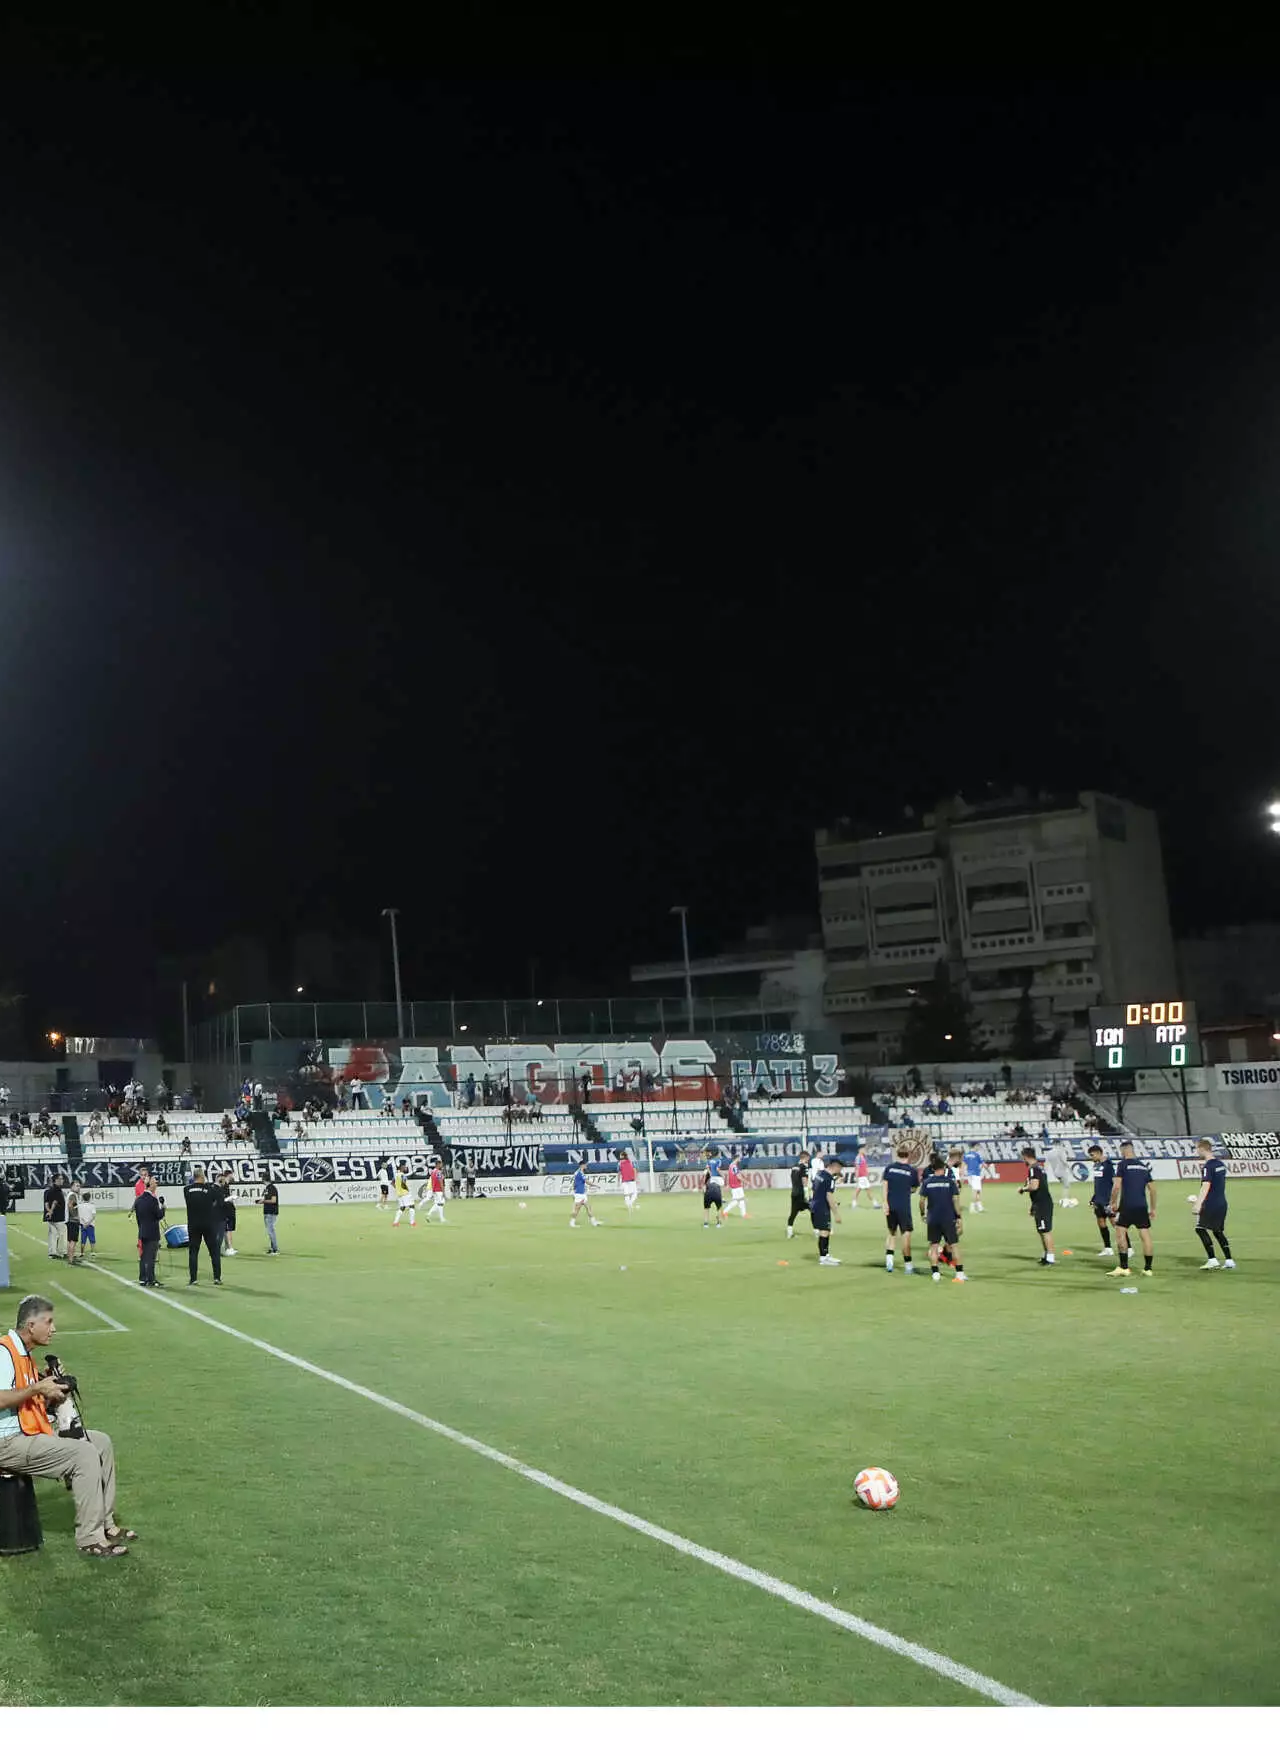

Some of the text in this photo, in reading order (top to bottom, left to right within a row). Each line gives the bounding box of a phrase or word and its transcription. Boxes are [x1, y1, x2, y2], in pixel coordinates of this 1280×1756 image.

[1126, 1001, 1183, 1025] 0:00
[1108, 1047, 1123, 1068] 0
[1170, 1044, 1186, 1066] 0
[1220, 1132, 1279, 1147] RANGERS
